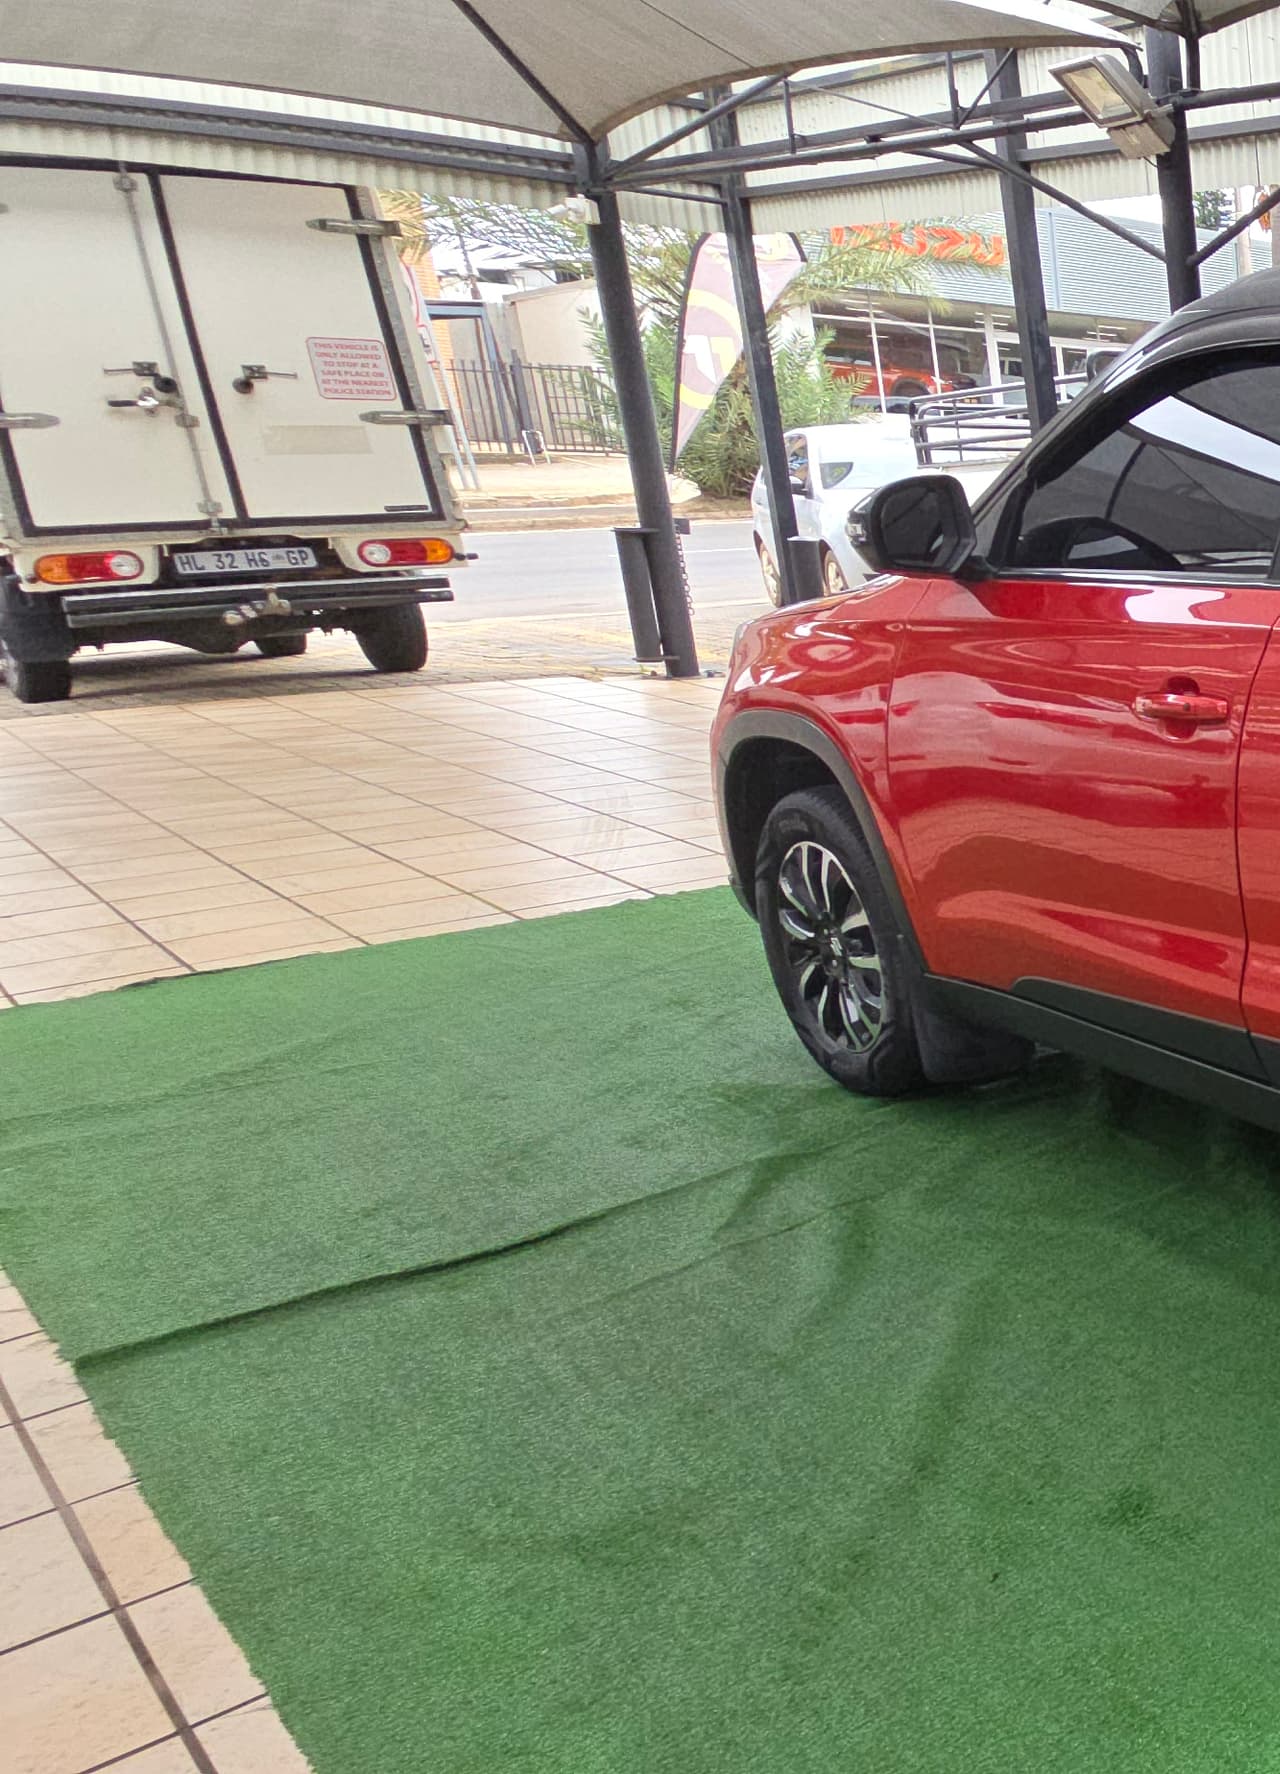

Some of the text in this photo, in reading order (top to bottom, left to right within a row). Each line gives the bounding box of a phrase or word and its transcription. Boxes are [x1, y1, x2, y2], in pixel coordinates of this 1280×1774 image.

[334, 343, 369, 351] VEHICLE
[354, 388, 392, 396] STATION
[178, 555, 206, 572] HL
[211, 552, 239, 570] 32
[285, 549, 309, 566] GP
